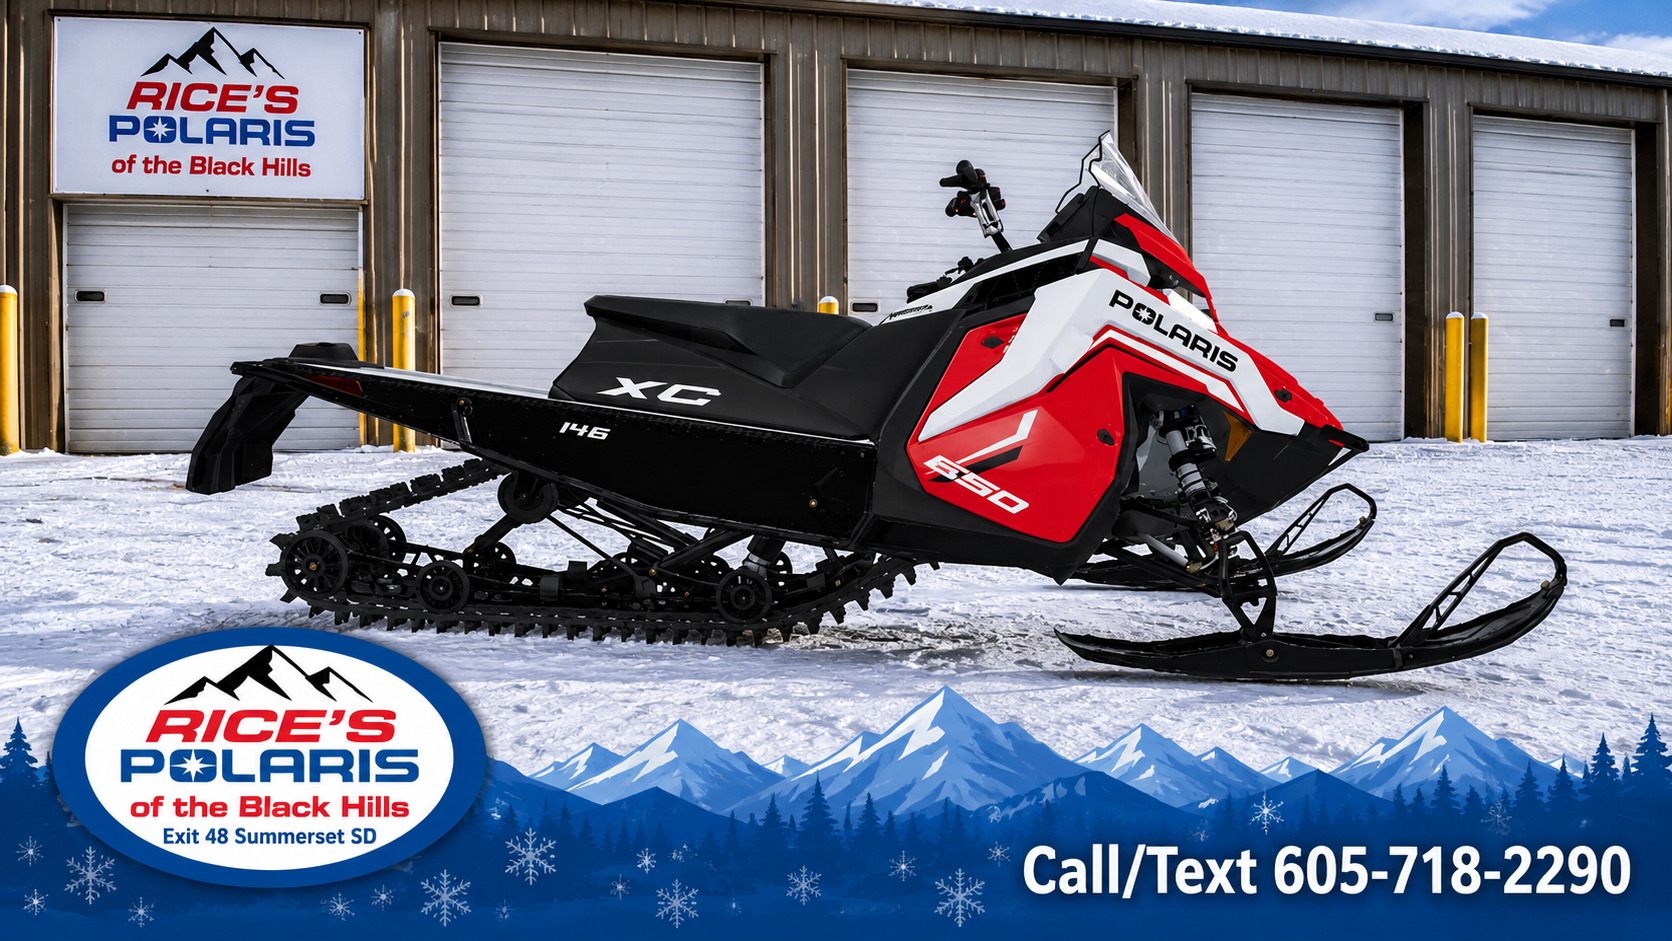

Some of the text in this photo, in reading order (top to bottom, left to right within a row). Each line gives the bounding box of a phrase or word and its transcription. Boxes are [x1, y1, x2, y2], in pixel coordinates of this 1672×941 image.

[127, 82, 299, 114] RICE'S
[109, 115, 315, 147] POLARIS
[112, 154, 312, 178] of the Black Hills
[1109, 289, 1238, 372] POLARIS
[596, 376, 722, 407] XC
[559, 422, 611, 440] 146
[923, 455, 1030, 514] 650
